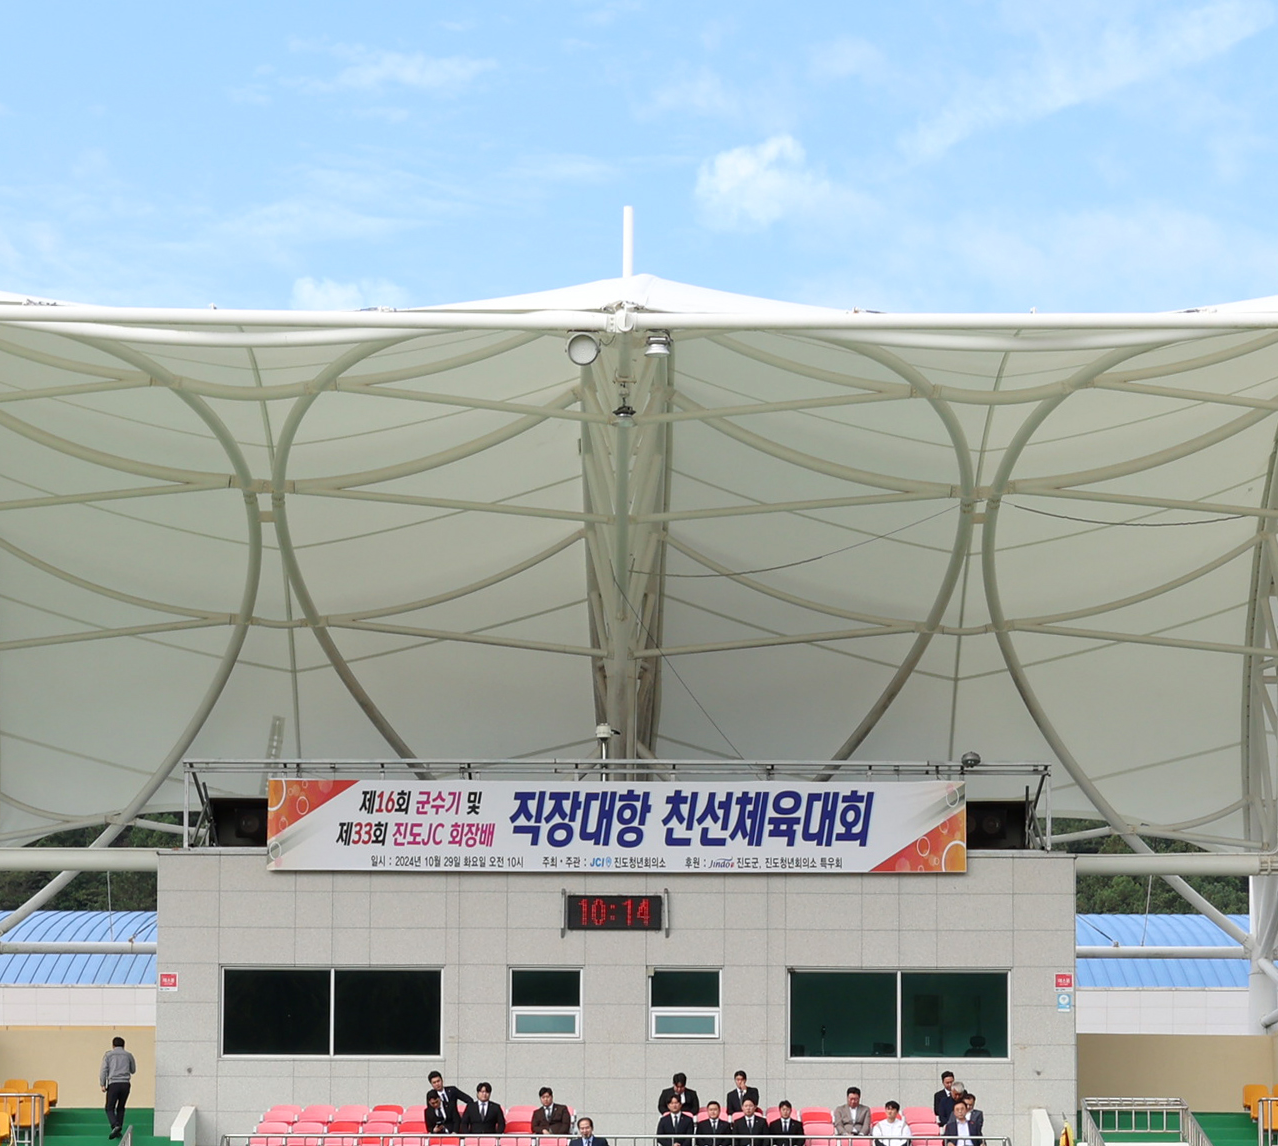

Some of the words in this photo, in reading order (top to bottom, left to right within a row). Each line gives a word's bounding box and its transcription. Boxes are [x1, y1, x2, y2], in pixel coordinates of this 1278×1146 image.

[359, 790, 412, 815] 제16회
[415, 790, 462, 815] 군수기
[466, 791, 482, 815] 및
[509, 789, 651, 848] 직장대항
[661, 790, 874, 848] 친선체육대회
[336, 821, 388, 846] 제33회
[392, 822, 445, 847] 진도JC
[448, 822, 496, 848] 회장배
[370, 855, 386, 868] 일시
[395, 856, 421, 868] 2024년
[425, 856, 441, 868] 10월
[443, 856, 461, 868] 29일
[463, 856, 486, 868] 화요일
[488, 856, 504, 868] 오전
[507, 856, 524, 868] 10시
[590, 857, 605, 868] JCI
[614, 856, 666, 869] 진도청년회의소
[685, 856, 700, 869] 후원
[765, 857, 817, 869] 진도청년회의소
[578, 898, 650, 926] 10:14
